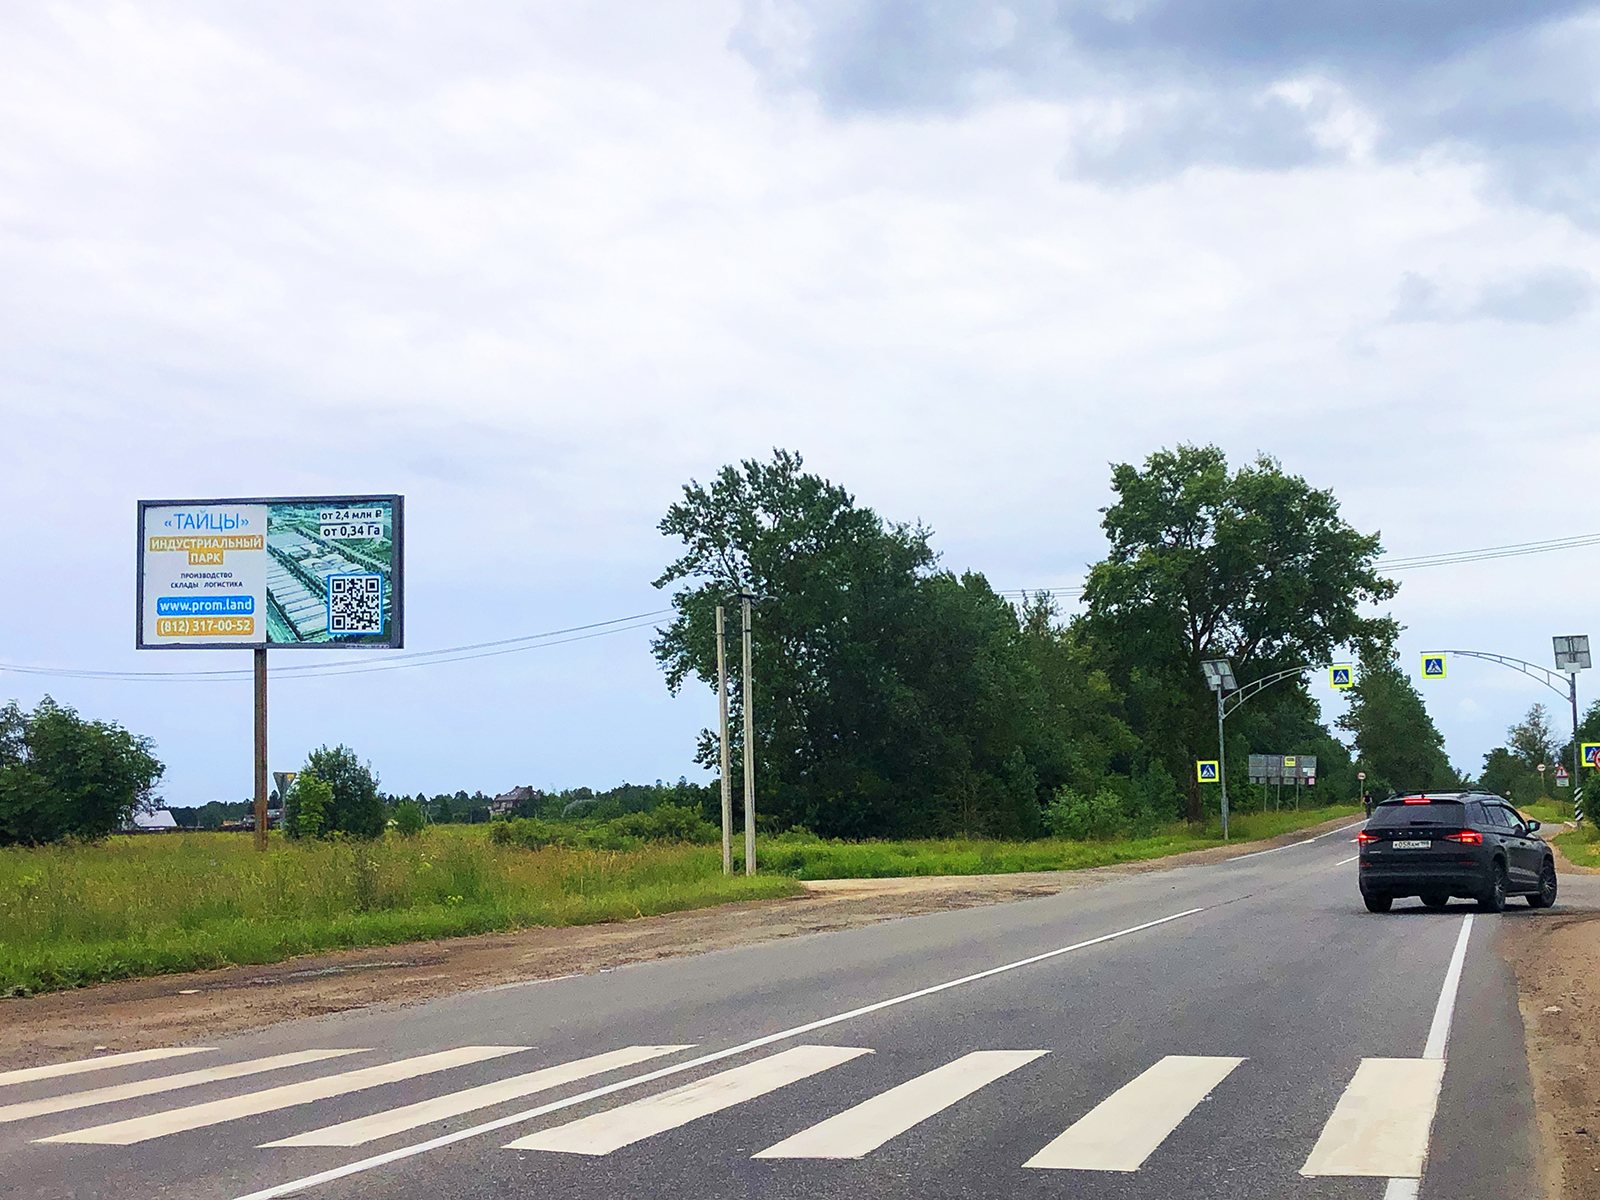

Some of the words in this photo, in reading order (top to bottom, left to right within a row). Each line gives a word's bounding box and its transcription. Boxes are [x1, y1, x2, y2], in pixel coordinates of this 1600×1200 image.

[164, 510, 249, 532] «ТАЙЦЫ»
[321, 512, 333, 520] от
[335, 511, 350, 521] 2,4
[352, 511, 372, 519] млн
[323, 528, 338, 537] от
[340, 525, 364, 538] 0,34
[367, 525, 380, 536] Га
[151, 536, 262, 551] ИНДУСТРИАЛЬНЫЙ
[190, 552, 221, 564] ПАРК
[159, 598, 252, 613] www.prom.land
[160, 620, 190, 634] (812)
[192, 619, 251, 633] 317-00-52
